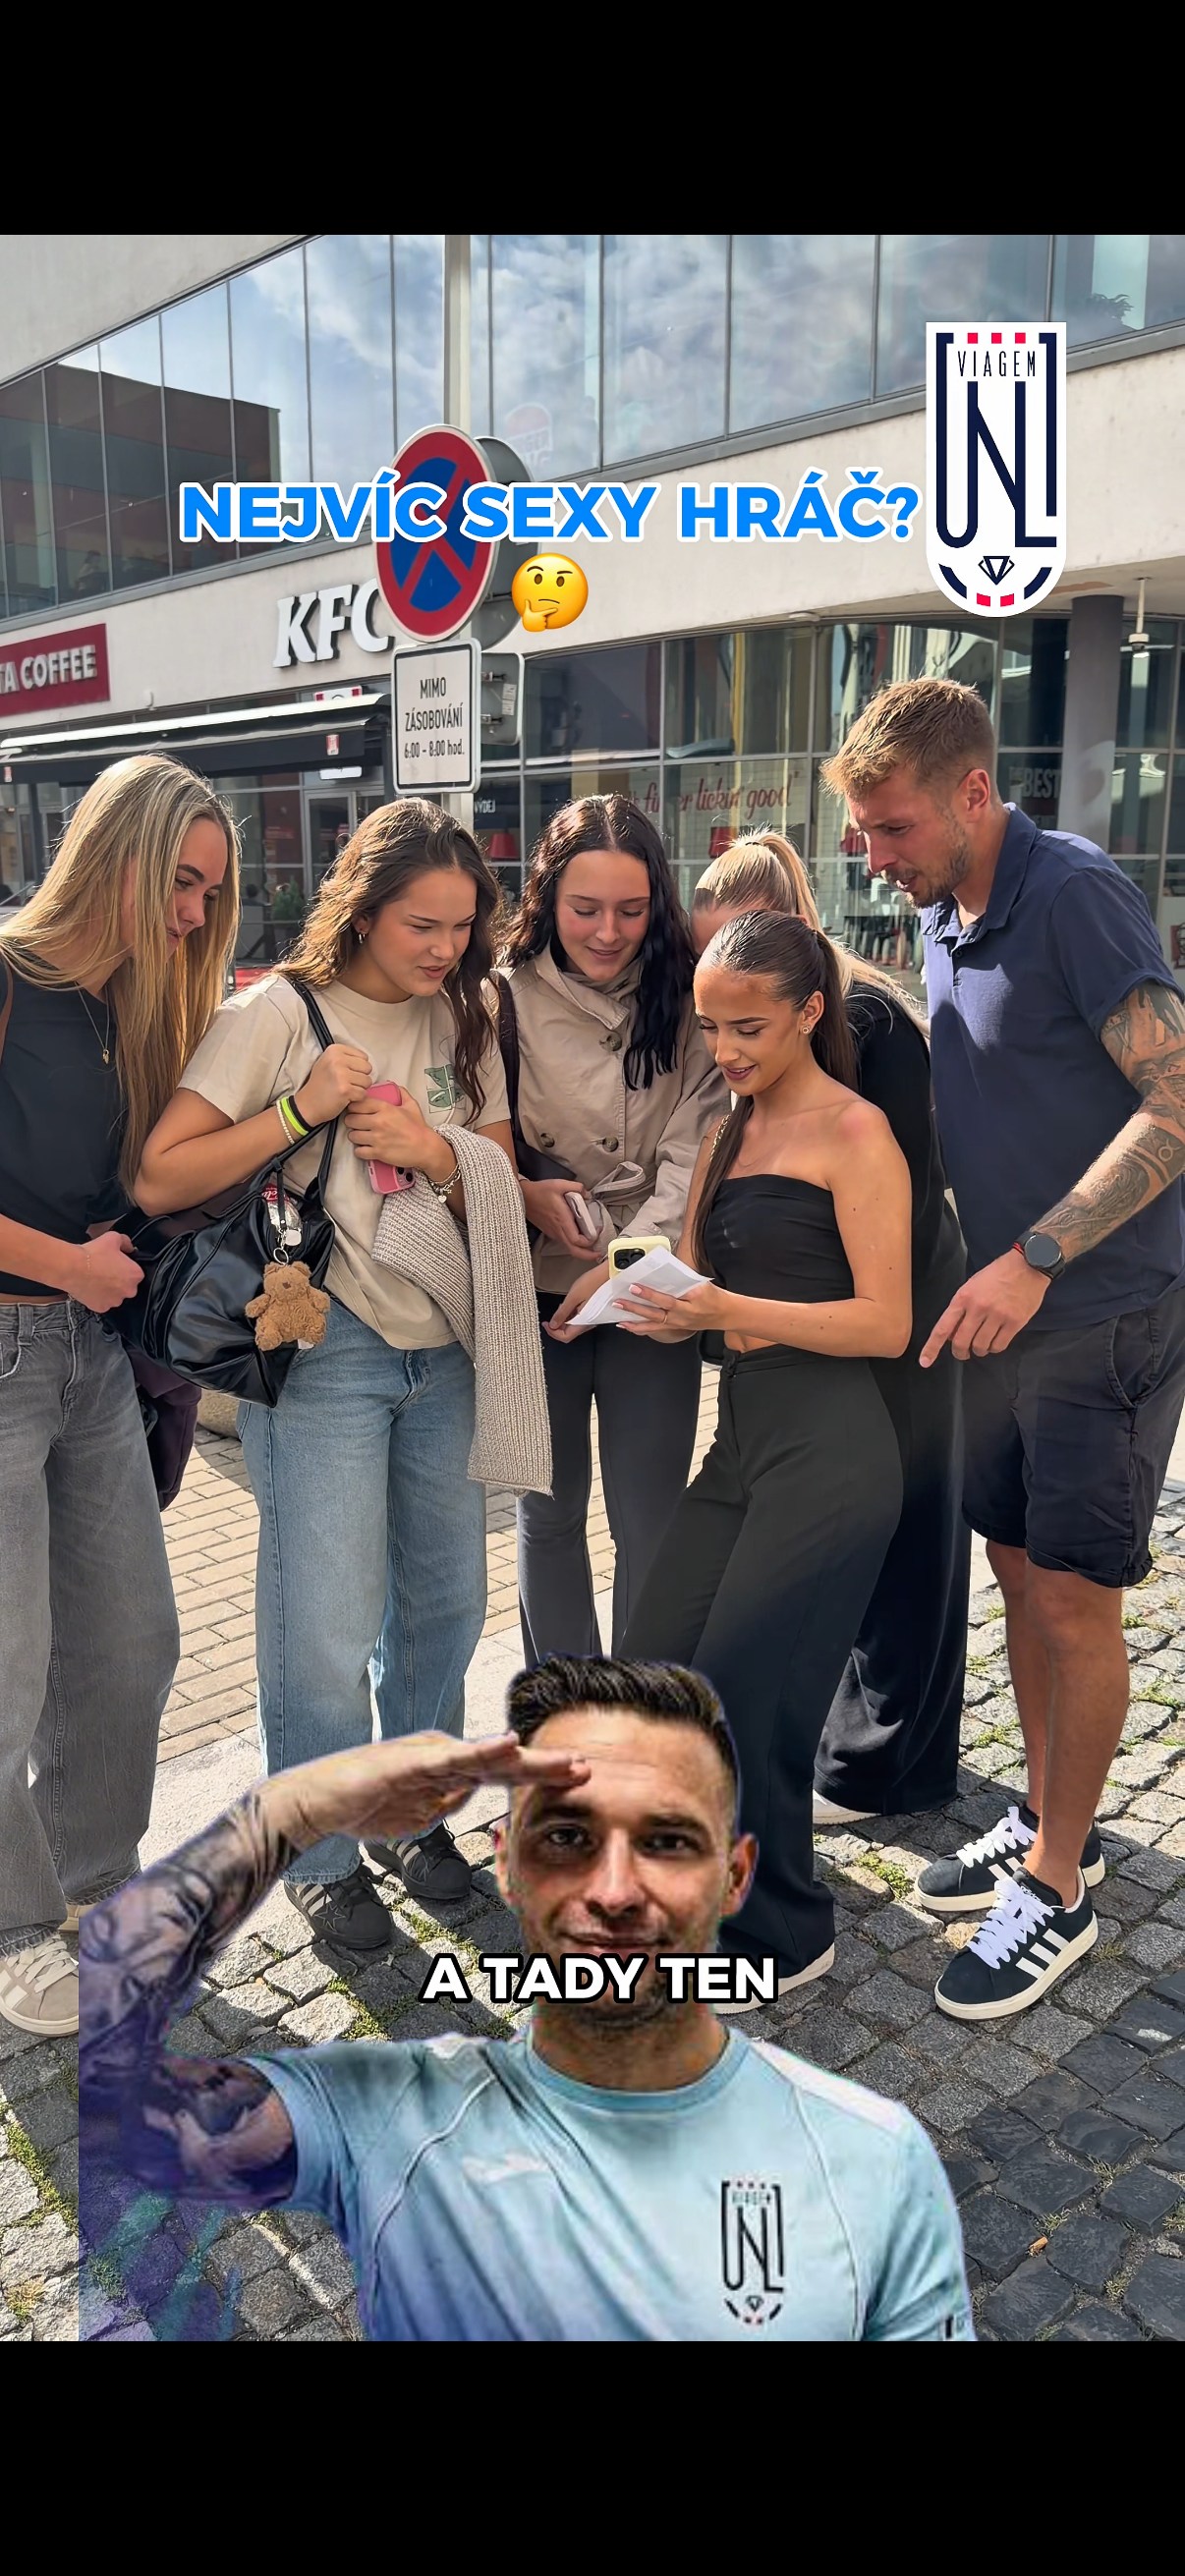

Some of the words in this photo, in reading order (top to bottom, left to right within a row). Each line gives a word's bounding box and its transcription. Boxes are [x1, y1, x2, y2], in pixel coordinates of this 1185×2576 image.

[273, 578, 393, 669] KFC
[21, 644, 97, 690] COFFEE
[420, 677, 447, 700] MIMO
[405, 702, 464, 732] ZÁSOBOVÁNÍ
[404, 742, 421, 758] 6:00
[428, 740, 445, 756] 8:00
[447, 739, 465, 756] hod.
